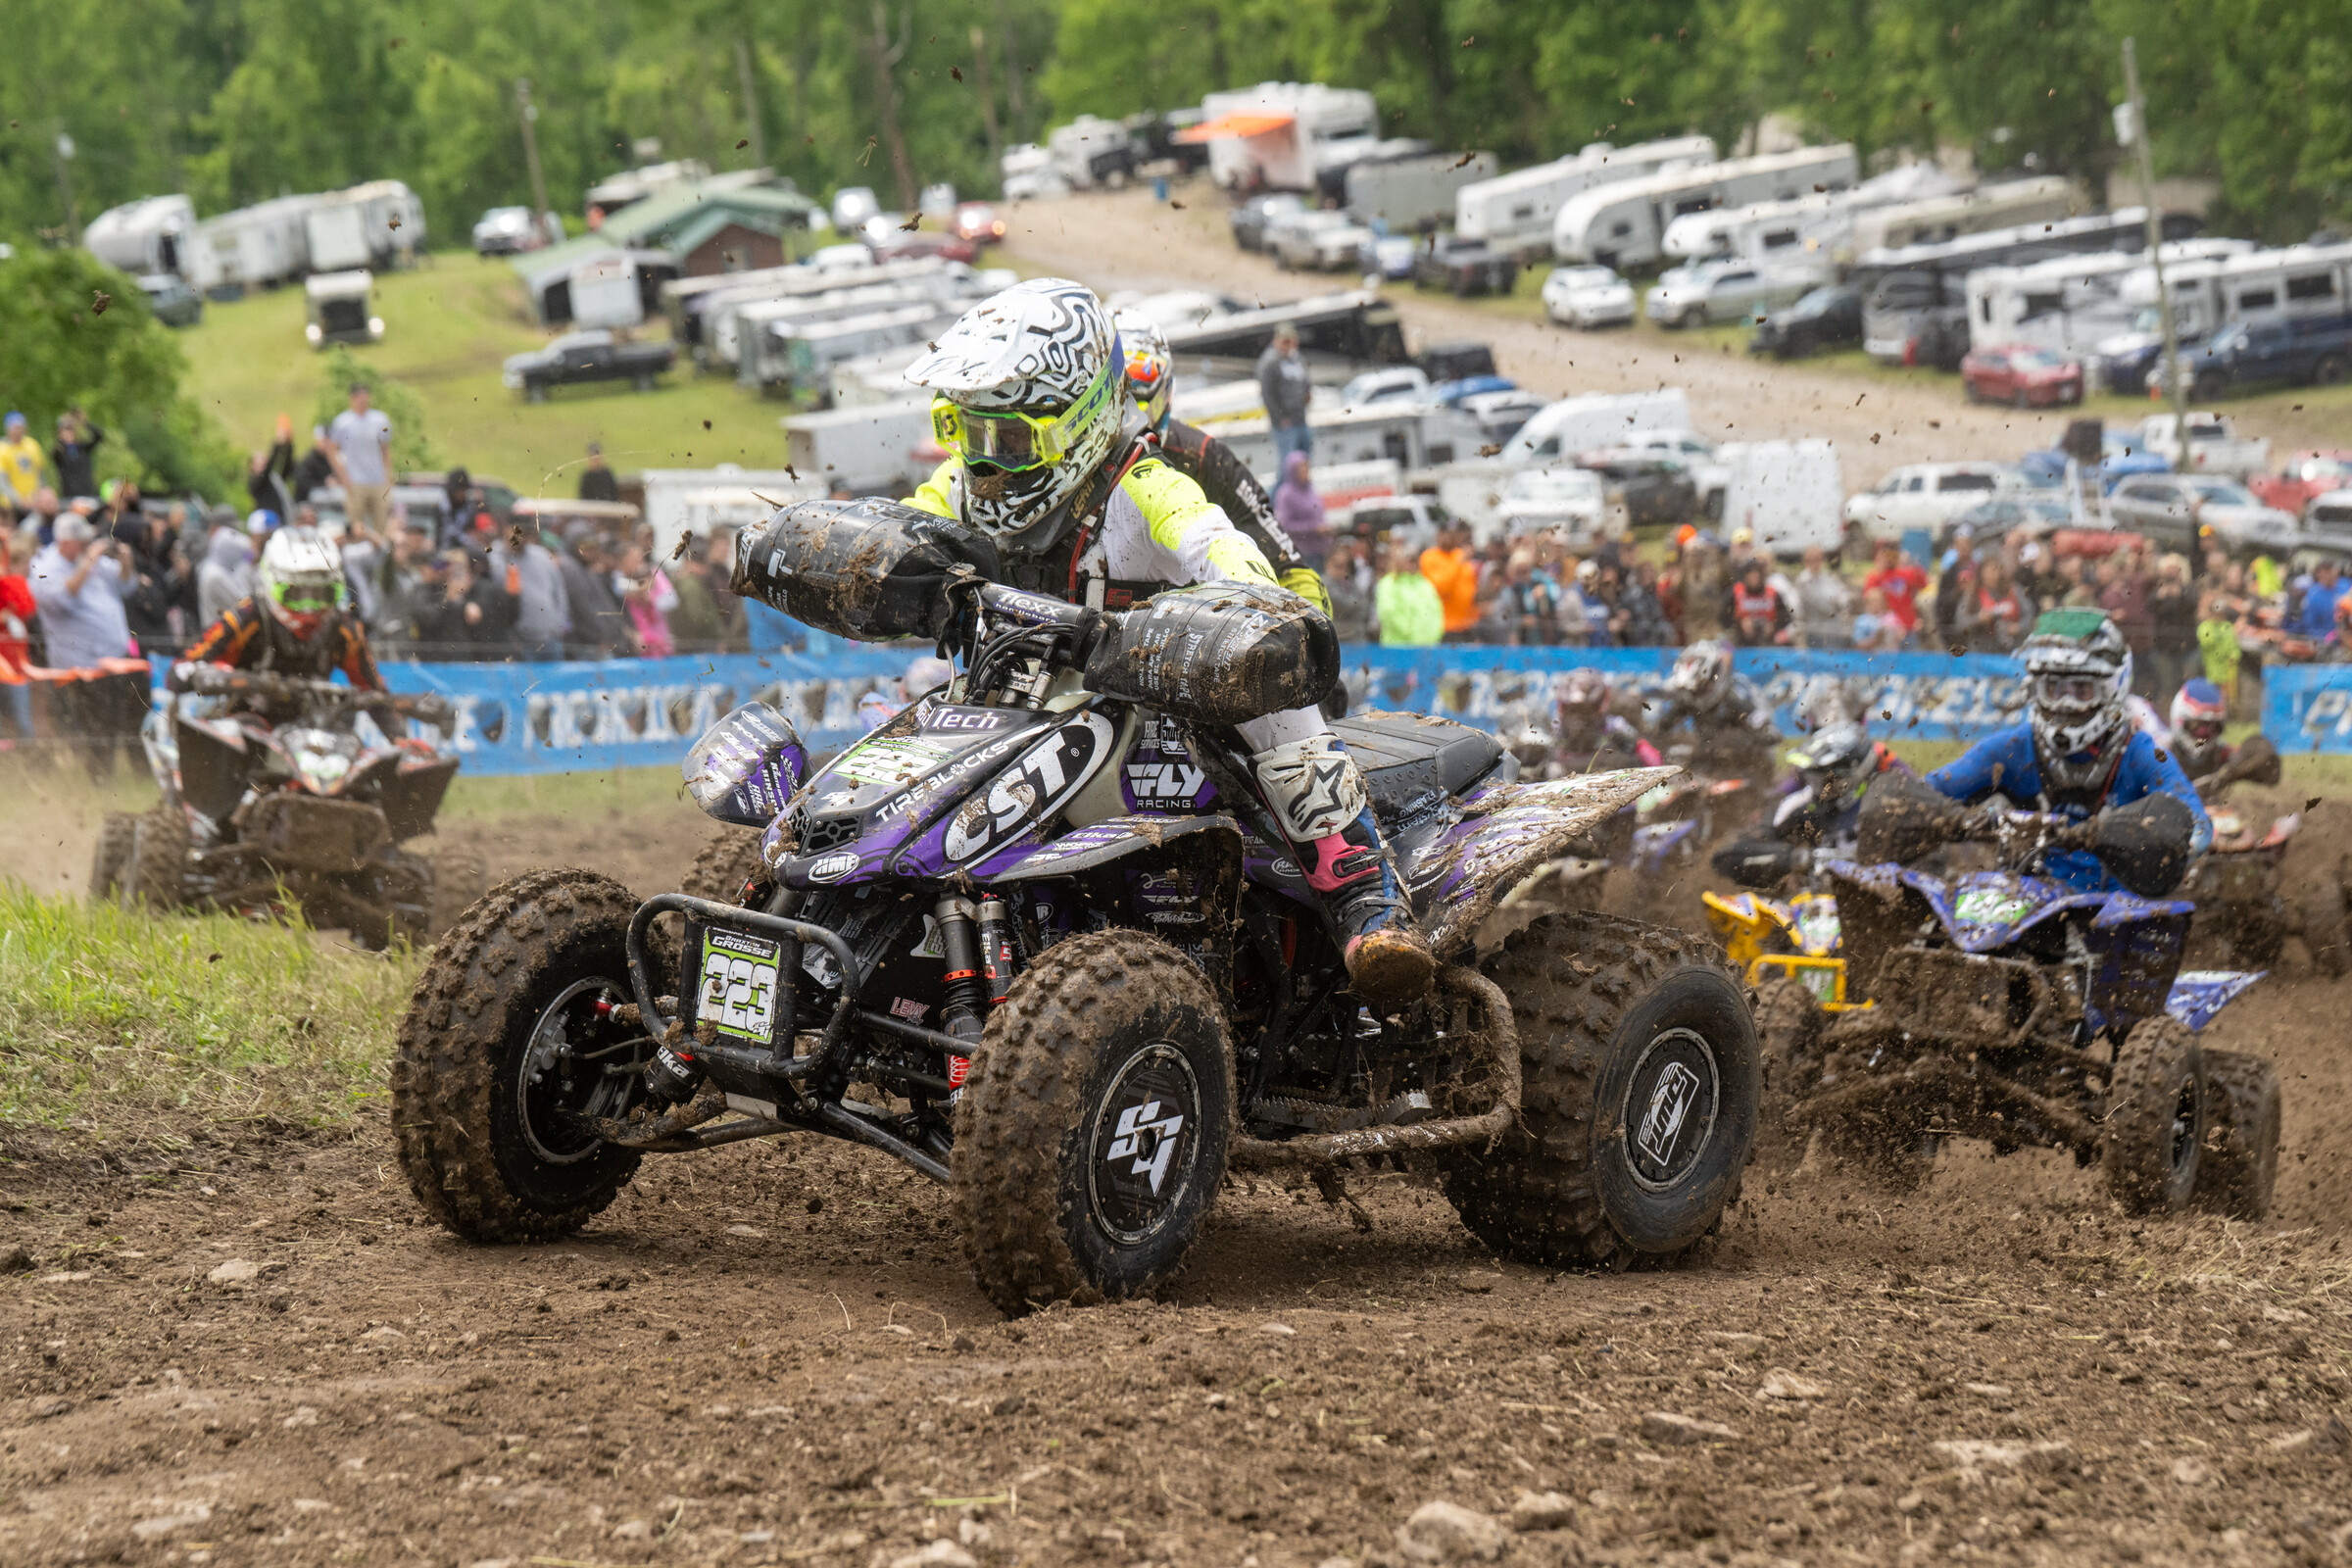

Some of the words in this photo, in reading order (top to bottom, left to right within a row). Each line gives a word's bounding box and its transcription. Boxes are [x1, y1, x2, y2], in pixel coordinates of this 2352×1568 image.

[1063, 374, 1112, 433] SCOT
[1182, 632, 1203, 677] STRETCH
[931, 708, 1000, 729] Tech
[834, 746, 940, 784] 223
[1126, 763, 1205, 797] FLY
[944, 730, 1079, 864] CST
[1137, 799, 1192, 808] RACING
[813, 853, 859, 876] HMF
[711, 935, 773, 958] GROSSE
[697, 952, 778, 1034] 223
[889, 996, 931, 1018] LEVY
[656, 1044, 690, 1079] Elka
